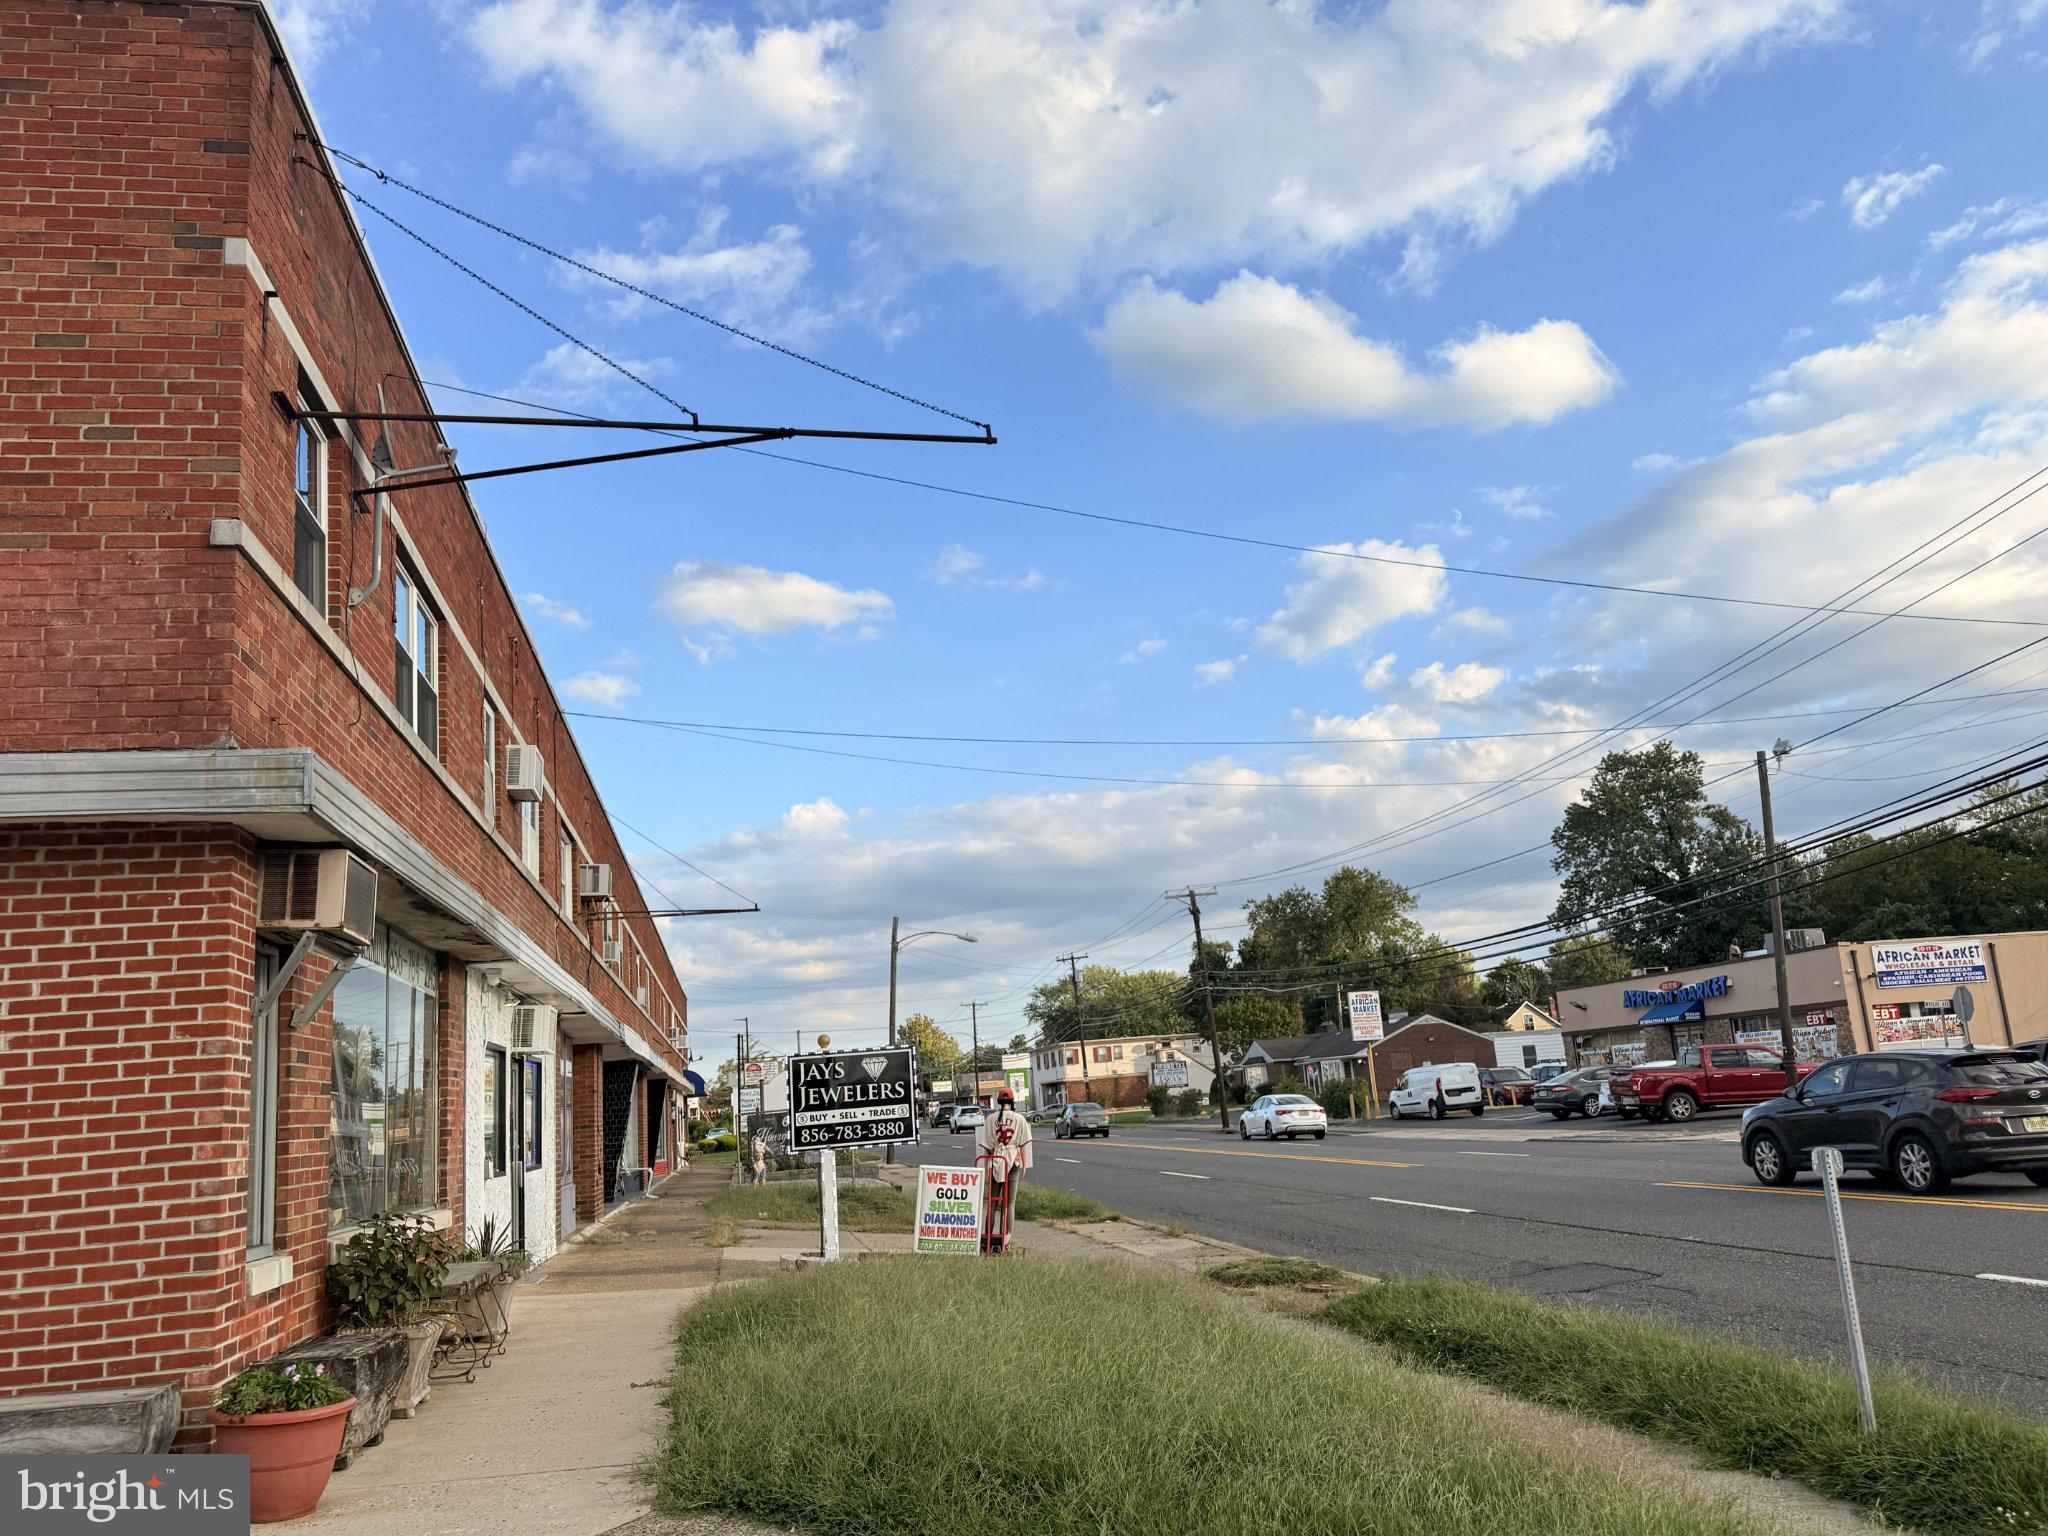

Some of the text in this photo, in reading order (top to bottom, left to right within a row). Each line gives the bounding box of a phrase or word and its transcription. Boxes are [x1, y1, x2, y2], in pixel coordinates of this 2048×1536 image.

[1877, 945, 1981, 963] AFRICAN MARKET
[1885, 960, 1935, 970] WHOLESALE
[1948, 959, 1976, 967] RETAIL
[1623, 975, 1728, 1008] AFRICAN MARKET
[1351, 998, 1379, 1006] AFRICAN
[1353, 1005, 1378, 1013] MARKET
[1873, 1008, 1898, 1020] EBT
[1806, 1013, 1825, 1026] EBT
[798, 1061, 845, 1086] JAYS
[798, 1081, 905, 1111] JEWELERS
[809, 1107, 896, 1122] BUY SELL TRADE
[801, 1121, 904, 1143] 856-783-3880
[927, 1172, 979, 1186] WE BUY
[936, 1187, 968, 1200] GOLD
[929, 1200, 973, 1213] SILVER
[924, 1213, 976, 1226] DIAMONDS
[920, 1225, 977, 1239] HIGH END WATCHES
